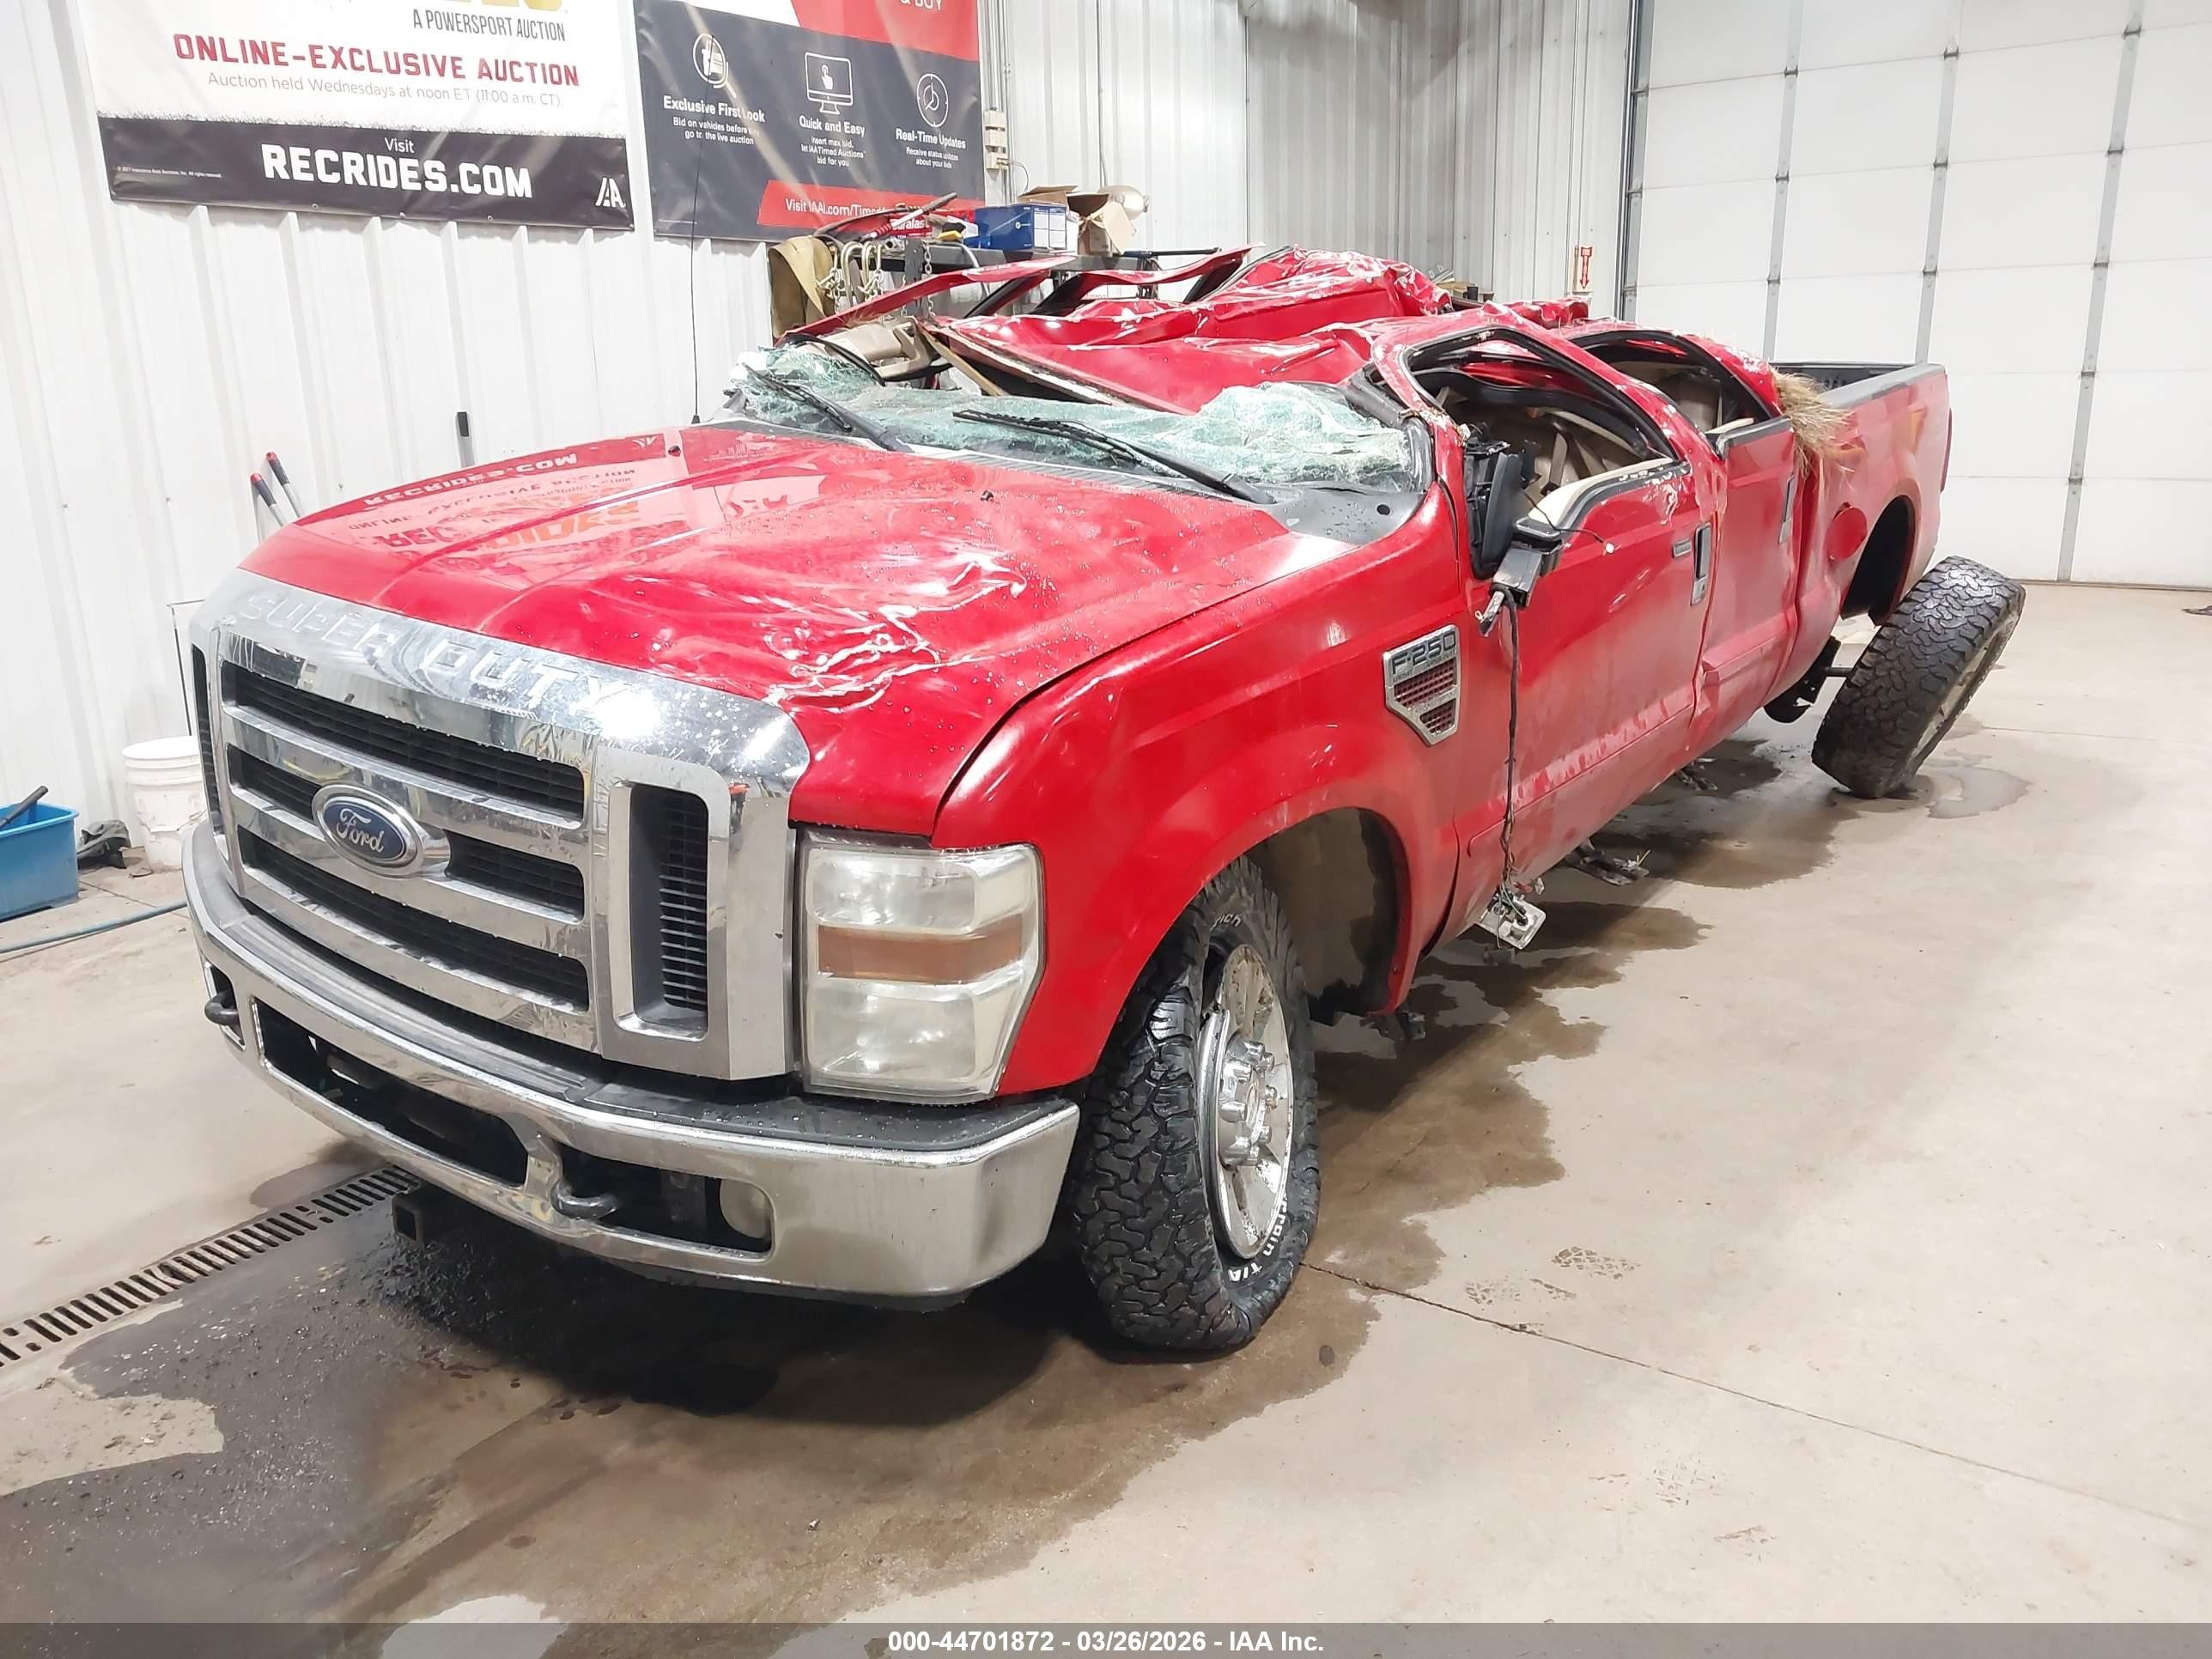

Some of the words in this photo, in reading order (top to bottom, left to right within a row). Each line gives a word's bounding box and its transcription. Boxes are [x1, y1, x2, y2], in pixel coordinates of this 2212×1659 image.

[413, 9, 422, 29] A
[425, 9, 512, 36] POWERSPORT
[516, 18, 566, 41] AUCTION
[173, 33, 466, 79] ONLINE-EXCLUSIVE
[477, 57, 580, 86] AUCTION
[208, 72, 267, 88] Auction
[271, 76, 303, 90] held
[308, 77, 395, 97] Wednesdays
[399, 86, 411, 98] at
[417, 88, 449, 100] noon
[453, 88, 471, 100] ET
[663, 95, 716, 115] Exclusive
[718, 102, 742, 118] First
[741, 106, 766, 123] Look
[672, 117, 686, 127] Bid
[699, 121, 725, 131] vehicles
[726, 124, 748, 134] before
[684, 131, 695, 139] go
[705, 131, 716, 141] the
[717, 132, 728, 143] live
[729, 135, 755, 145] auction
[799, 115, 823, 131] Quick
[824, 121, 842, 132] and
[843, 121, 866, 137] Easy
[384, 137, 416, 154] Visit
[895, 128, 938, 144] Real-Time
[939, 133, 966, 149] Updates
[261, 143, 532, 198] RECRIDES.COM
[817, 155, 826, 165] bid
[827, 156, 837, 166] for
[837, 159, 849, 167] you
[785, 198, 807, 212] Visit
[240, 596, 399, 658] SUPER
[419, 638, 640, 711] DUTY
[336, 807, 385, 853] Ford
